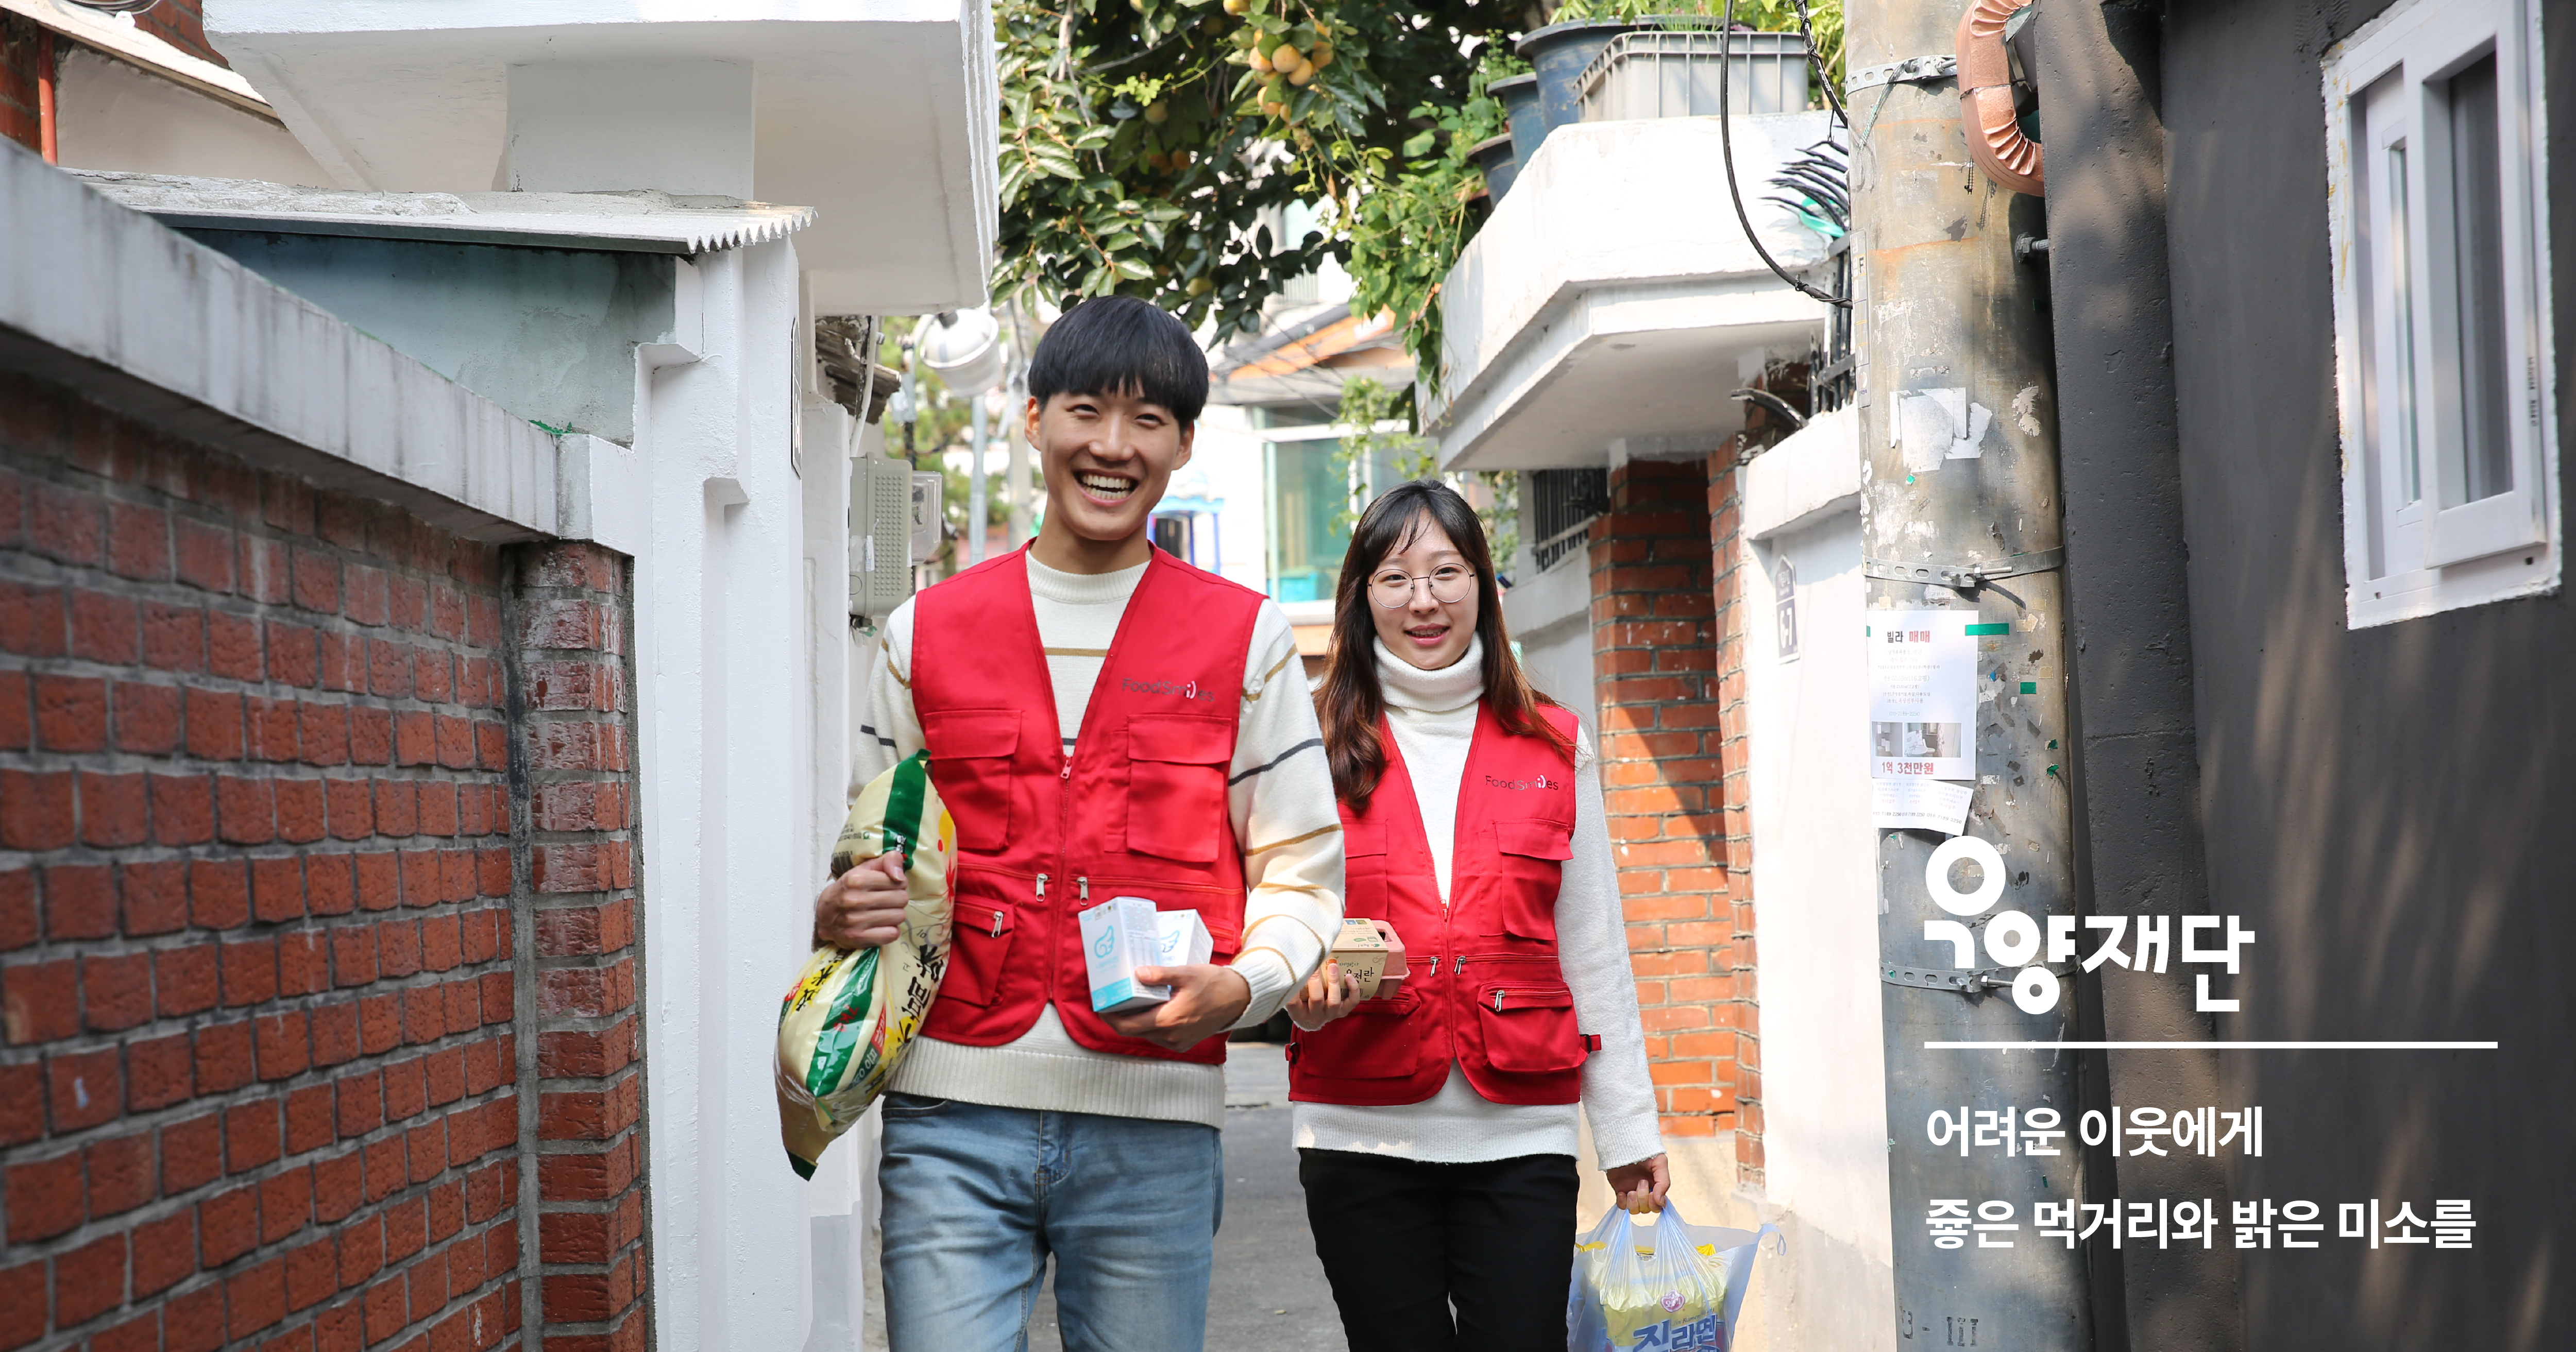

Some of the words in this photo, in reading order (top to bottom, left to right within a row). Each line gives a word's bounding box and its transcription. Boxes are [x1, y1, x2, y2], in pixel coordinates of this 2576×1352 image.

[1887, 630, 1904, 643] 빌라
[1909, 630, 1930, 643] 매매
[1882, 761, 1893, 774] 1억
[1897, 762, 1934, 775] 3천만원
